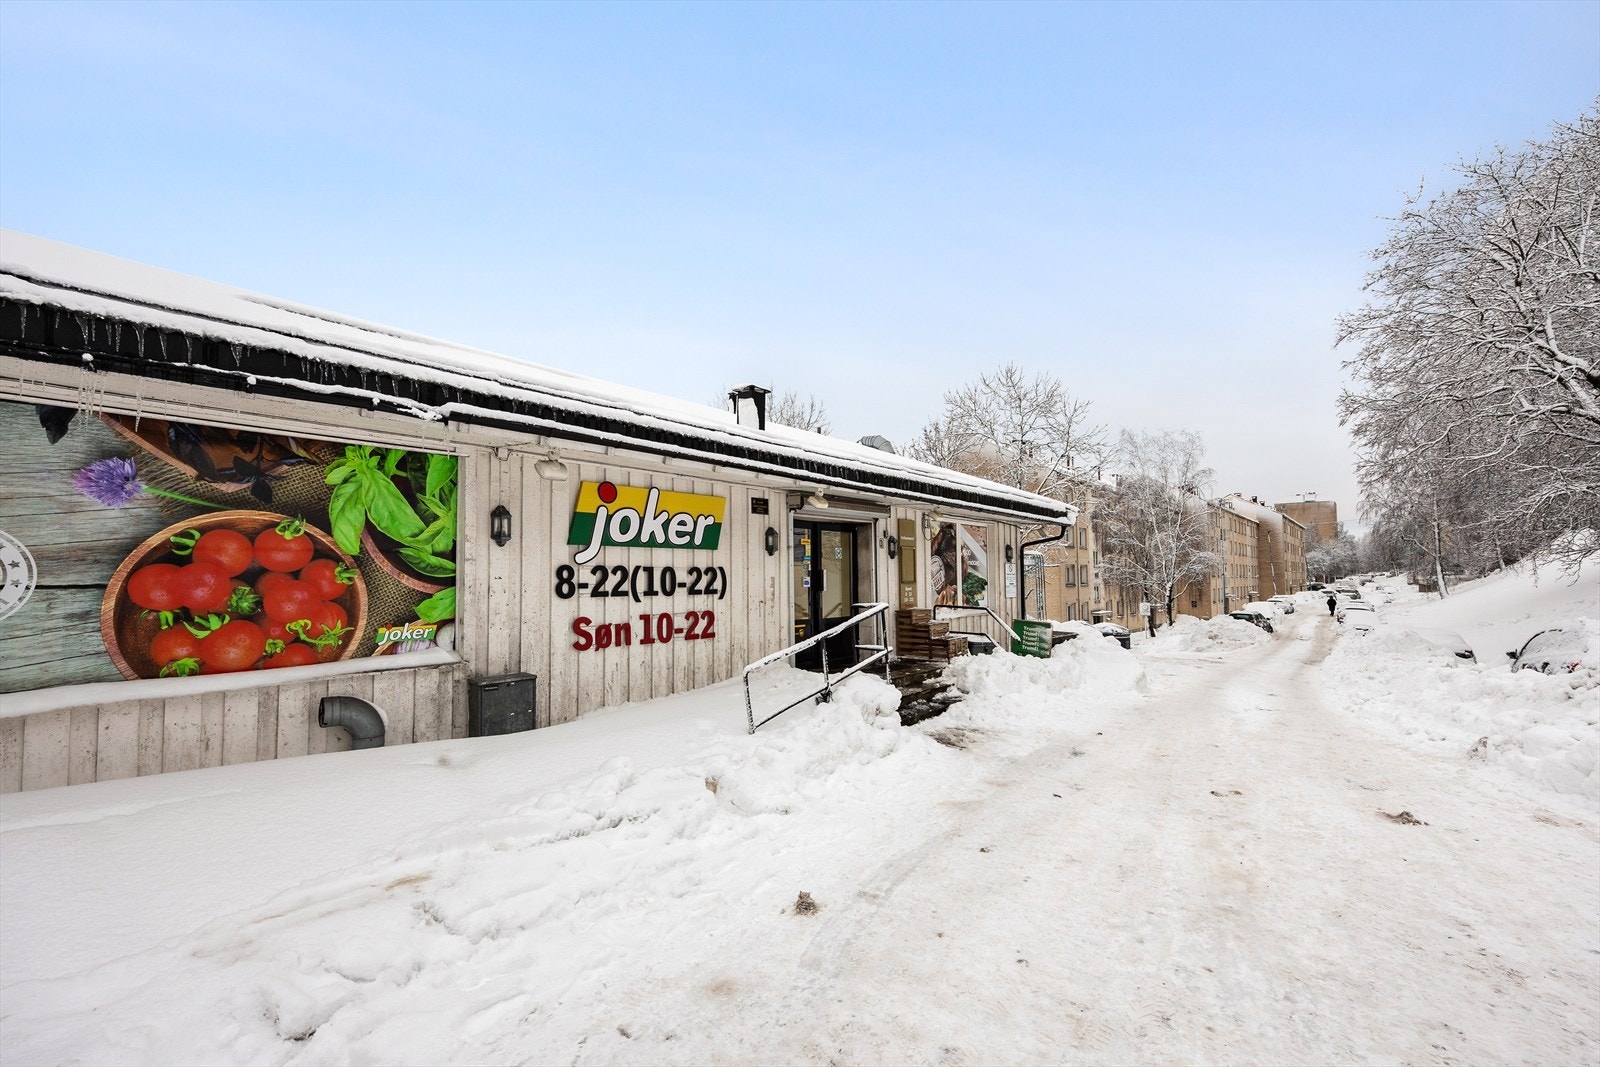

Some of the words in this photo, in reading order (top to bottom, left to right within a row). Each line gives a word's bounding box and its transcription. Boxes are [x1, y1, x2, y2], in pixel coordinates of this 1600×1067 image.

[574, 481, 715, 565] joker
[555, 564, 727, 602] 8-22(10-22)
[377, 622, 432, 646] joker
[572, 616, 632, 652] Søn
[639, 610, 716, 645] 10-22
